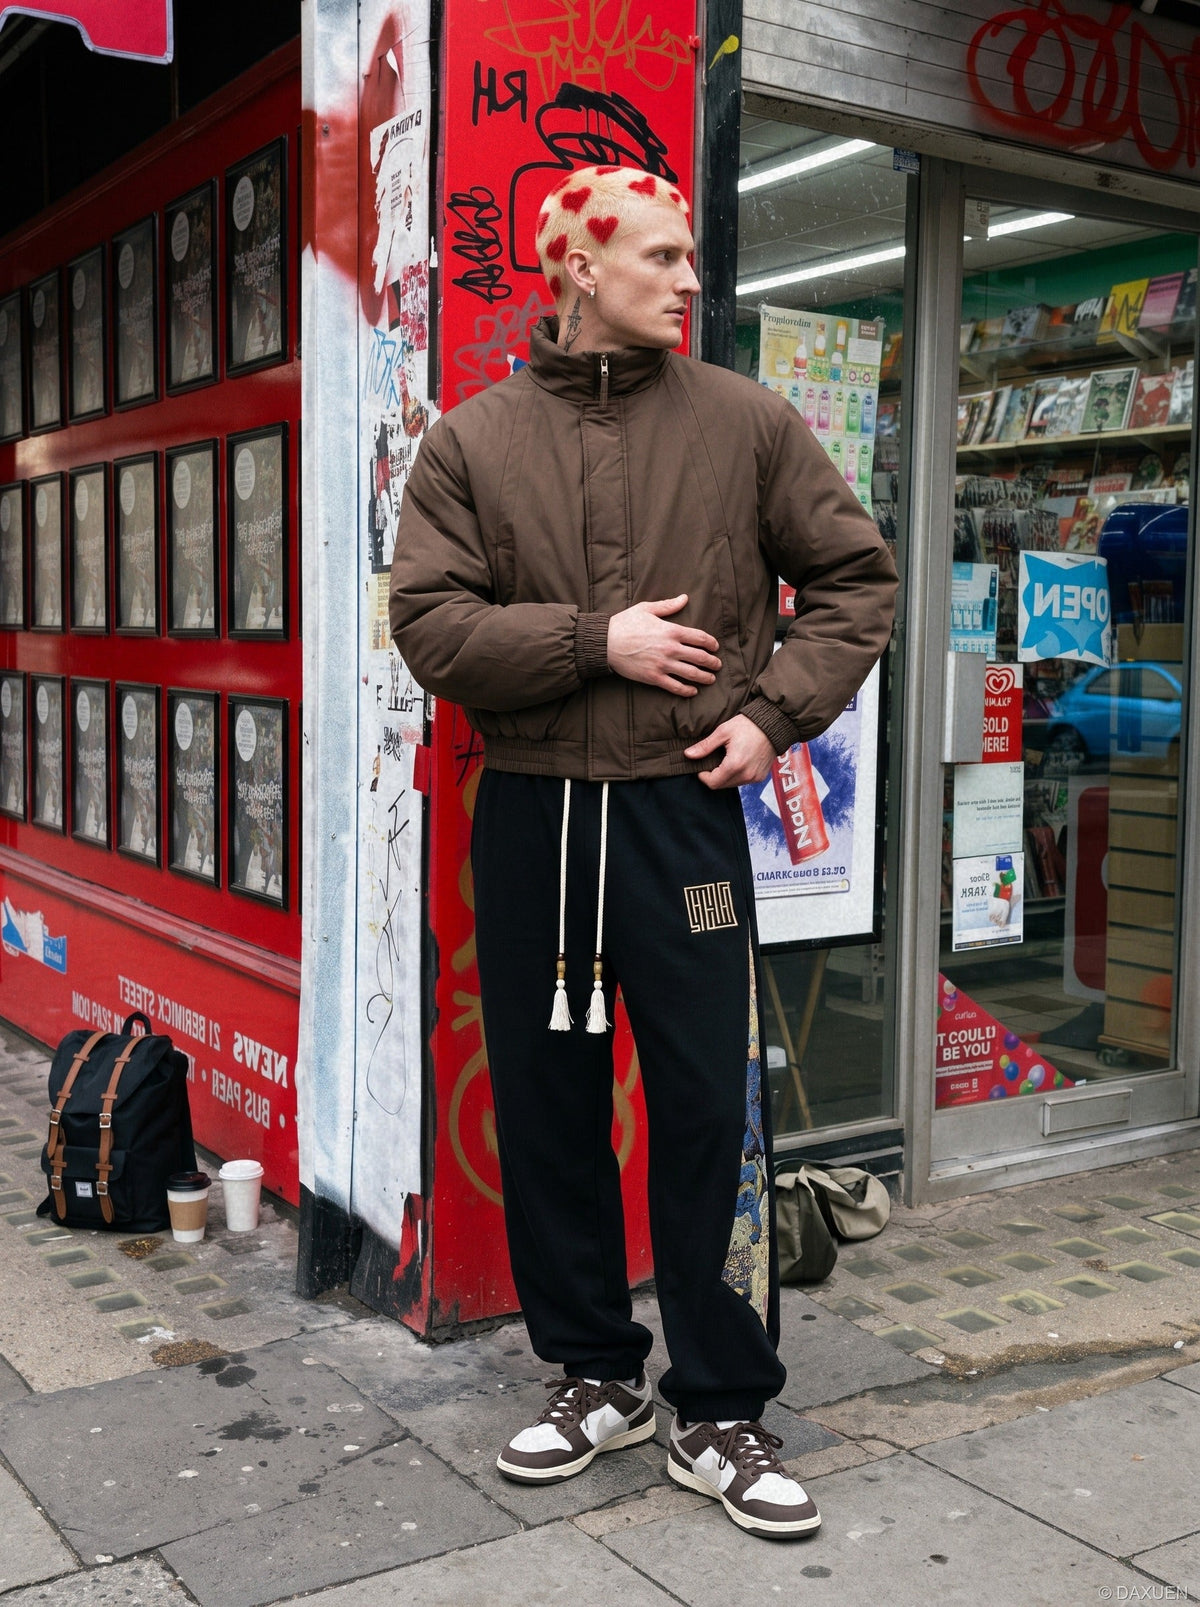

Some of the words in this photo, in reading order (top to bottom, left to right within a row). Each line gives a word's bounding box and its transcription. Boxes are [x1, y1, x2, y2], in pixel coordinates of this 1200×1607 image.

[983, 716, 1009, 734] SOLD
[943, 1046, 961, 1061] BE
[962, 1041, 991, 1058] YOU
